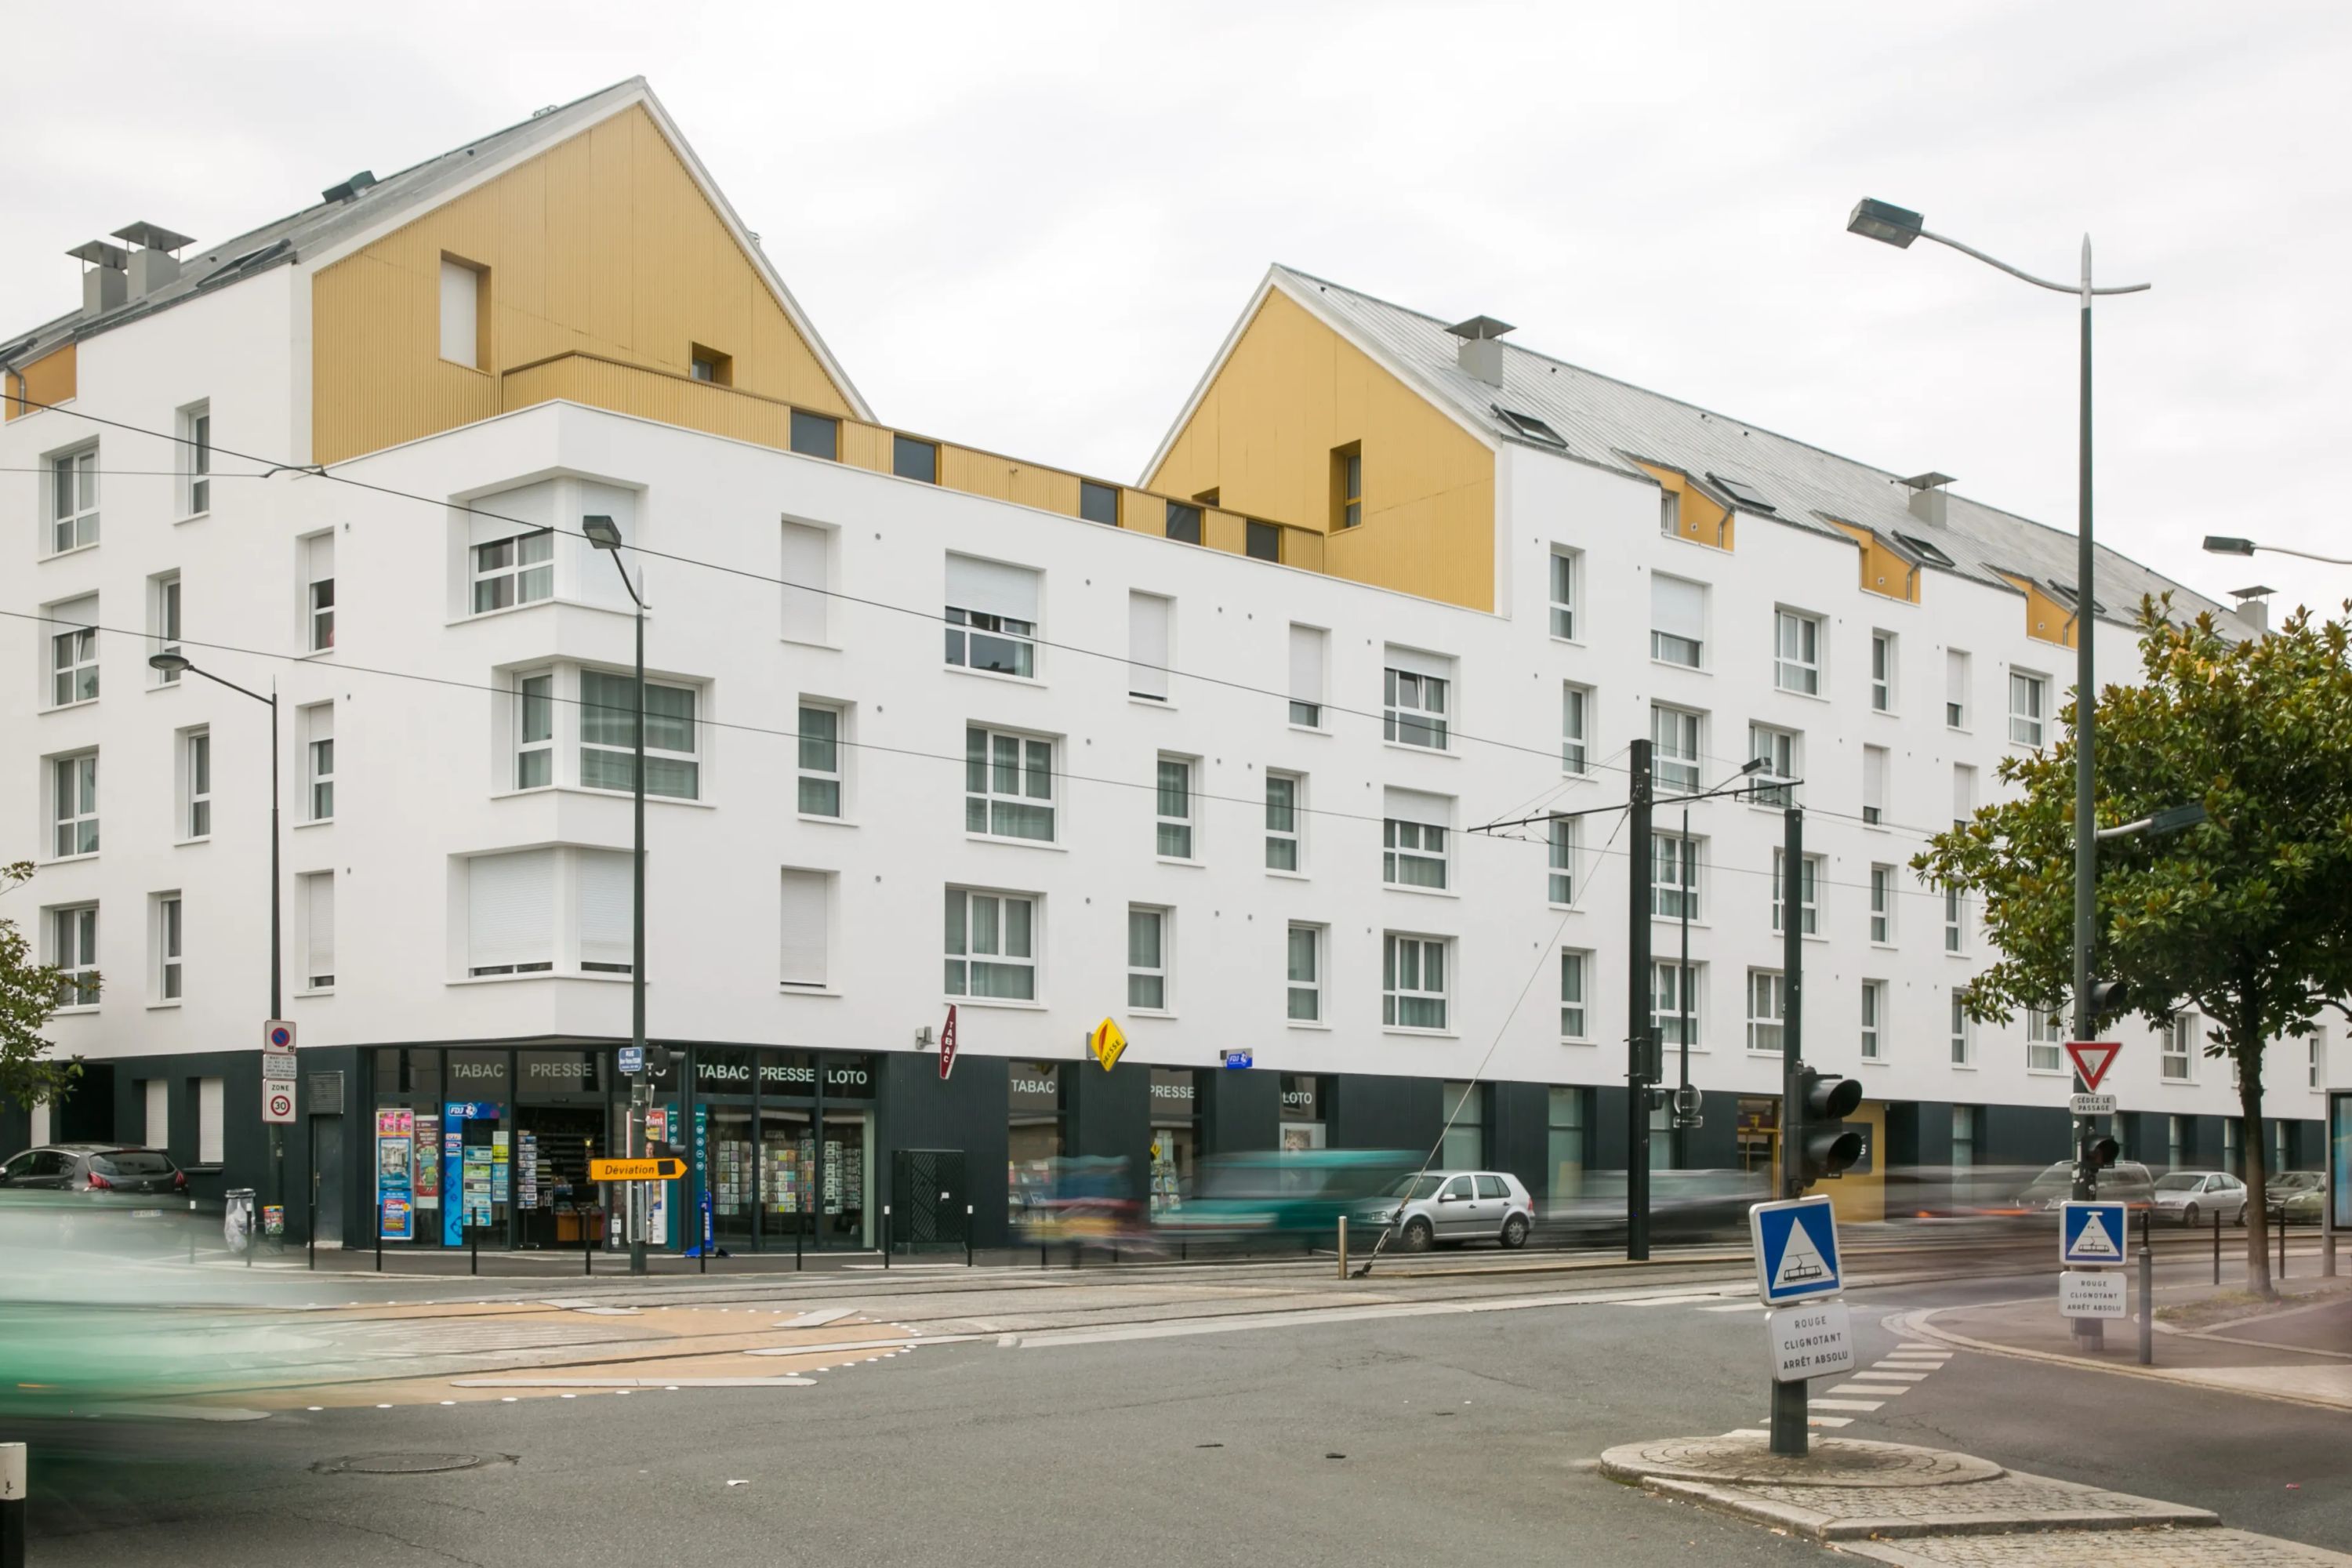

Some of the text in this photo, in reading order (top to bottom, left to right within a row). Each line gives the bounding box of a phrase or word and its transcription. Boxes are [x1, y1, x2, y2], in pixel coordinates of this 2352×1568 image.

[943, 1021, 954, 1062] TABAC
[1103, 1039, 1121, 1065] PRESSE
[452, 1063, 593, 1078] TABAC PRESSE
[696, 1064, 867, 1084] TABAC PRESSE LOTO
[1011, 1079, 1055, 1094] TABAC
[1283, 1091, 1312, 1105] LOTO
[274, 1101, 287, 1110] 30
[604, 1164, 655, 1174] Déviation
[1794, 1316, 1827, 1329] ROUGE
[1784, 1332, 1842, 1350] CLIGNOTANT
[1783, 1350, 1849, 1370] ARRÊT ABSOLU
